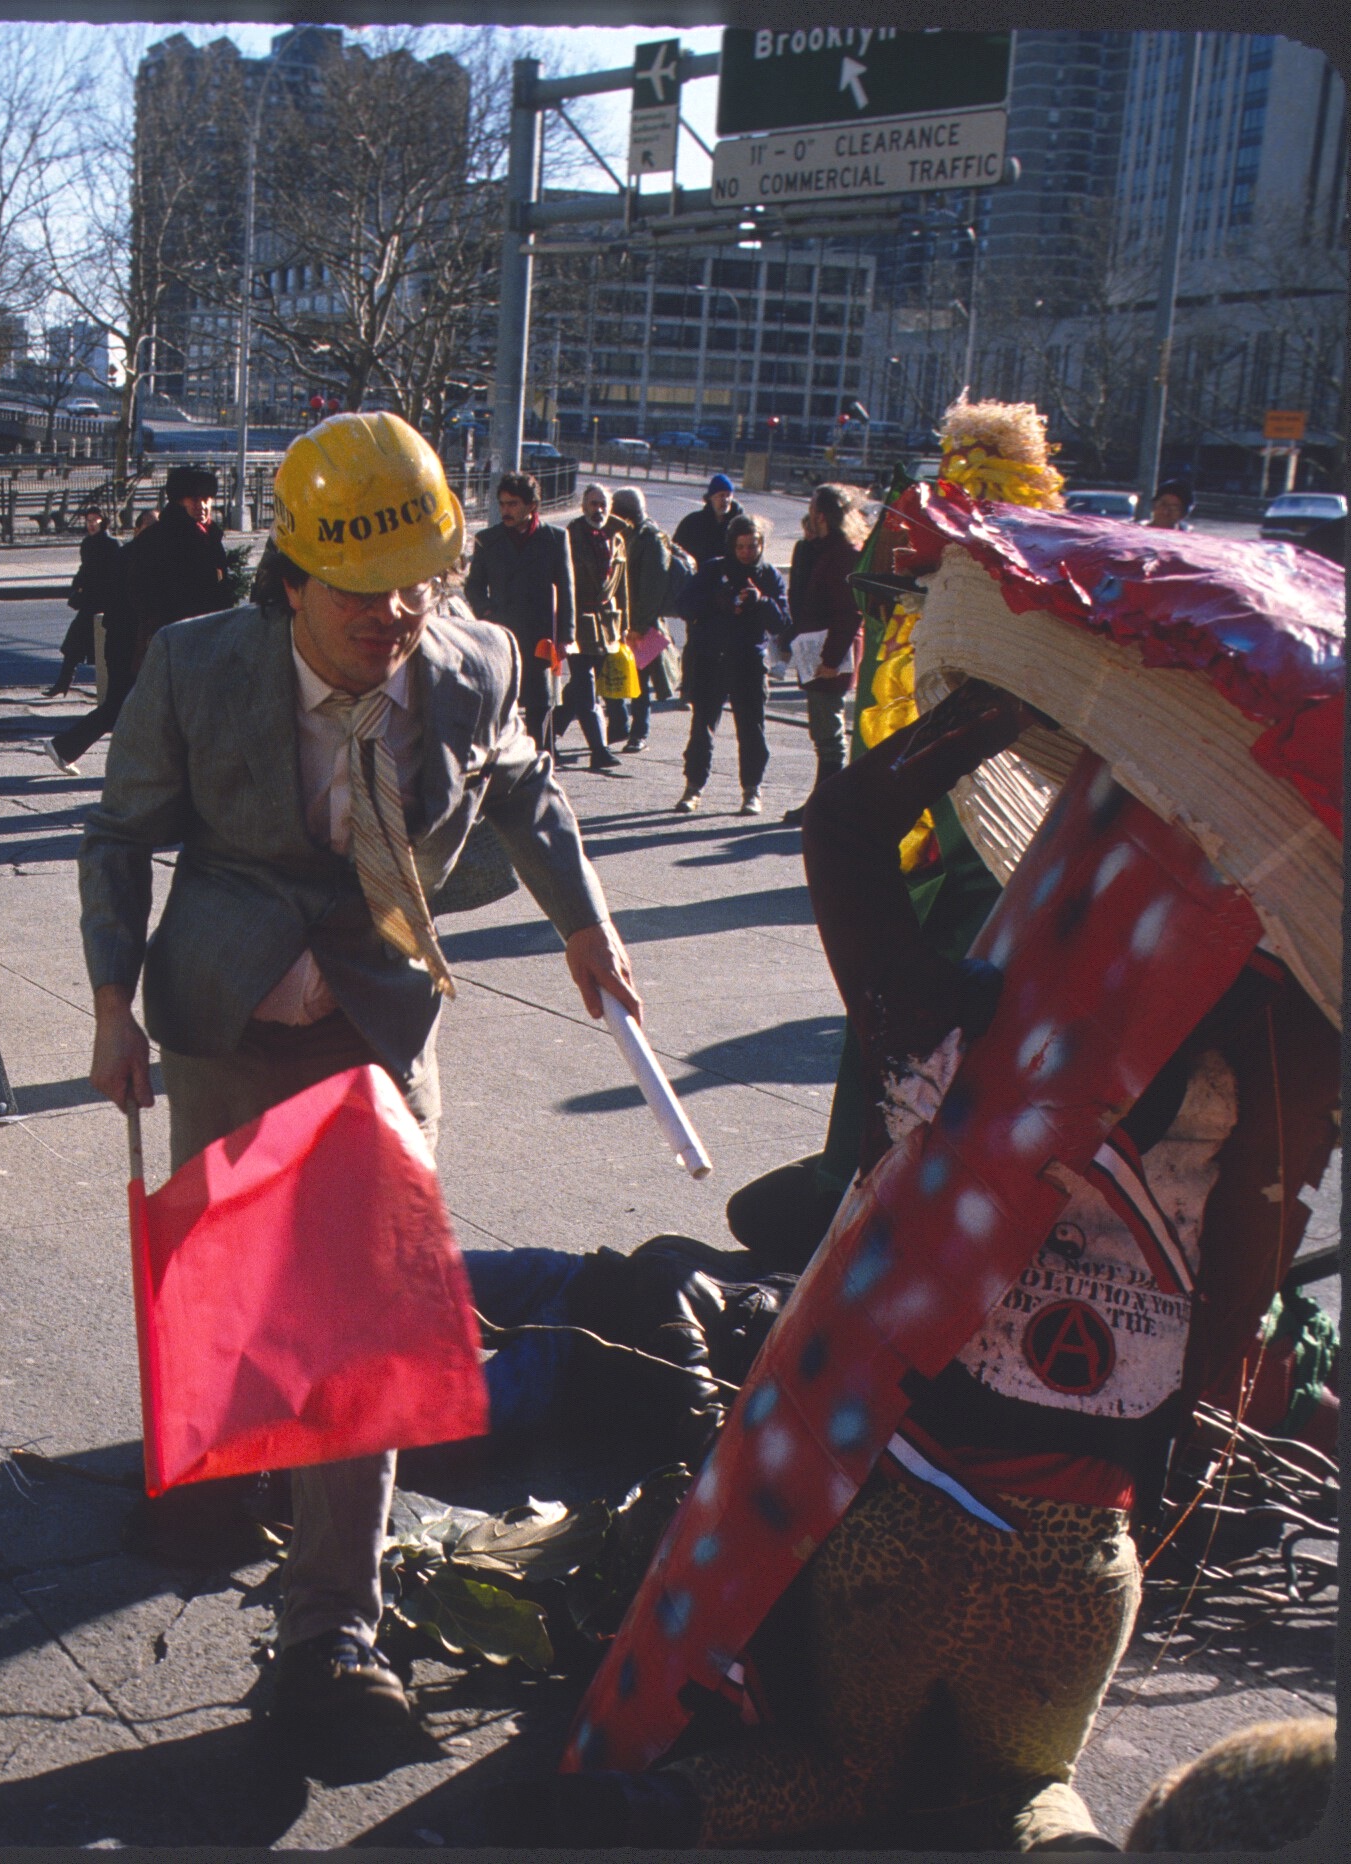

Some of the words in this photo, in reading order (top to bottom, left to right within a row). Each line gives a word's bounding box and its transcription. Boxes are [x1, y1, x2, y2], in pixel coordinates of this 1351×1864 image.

[835, 122, 961, 157] CLEARANCE
[714, 177, 739, 199] NO
[759, 165, 885, 195] COMMERCIAL
[908, 152, 997, 183] TRAFFIC
[317, 491, 437, 544] MOBCO
[1106, 1306, 1157, 1336] THE
